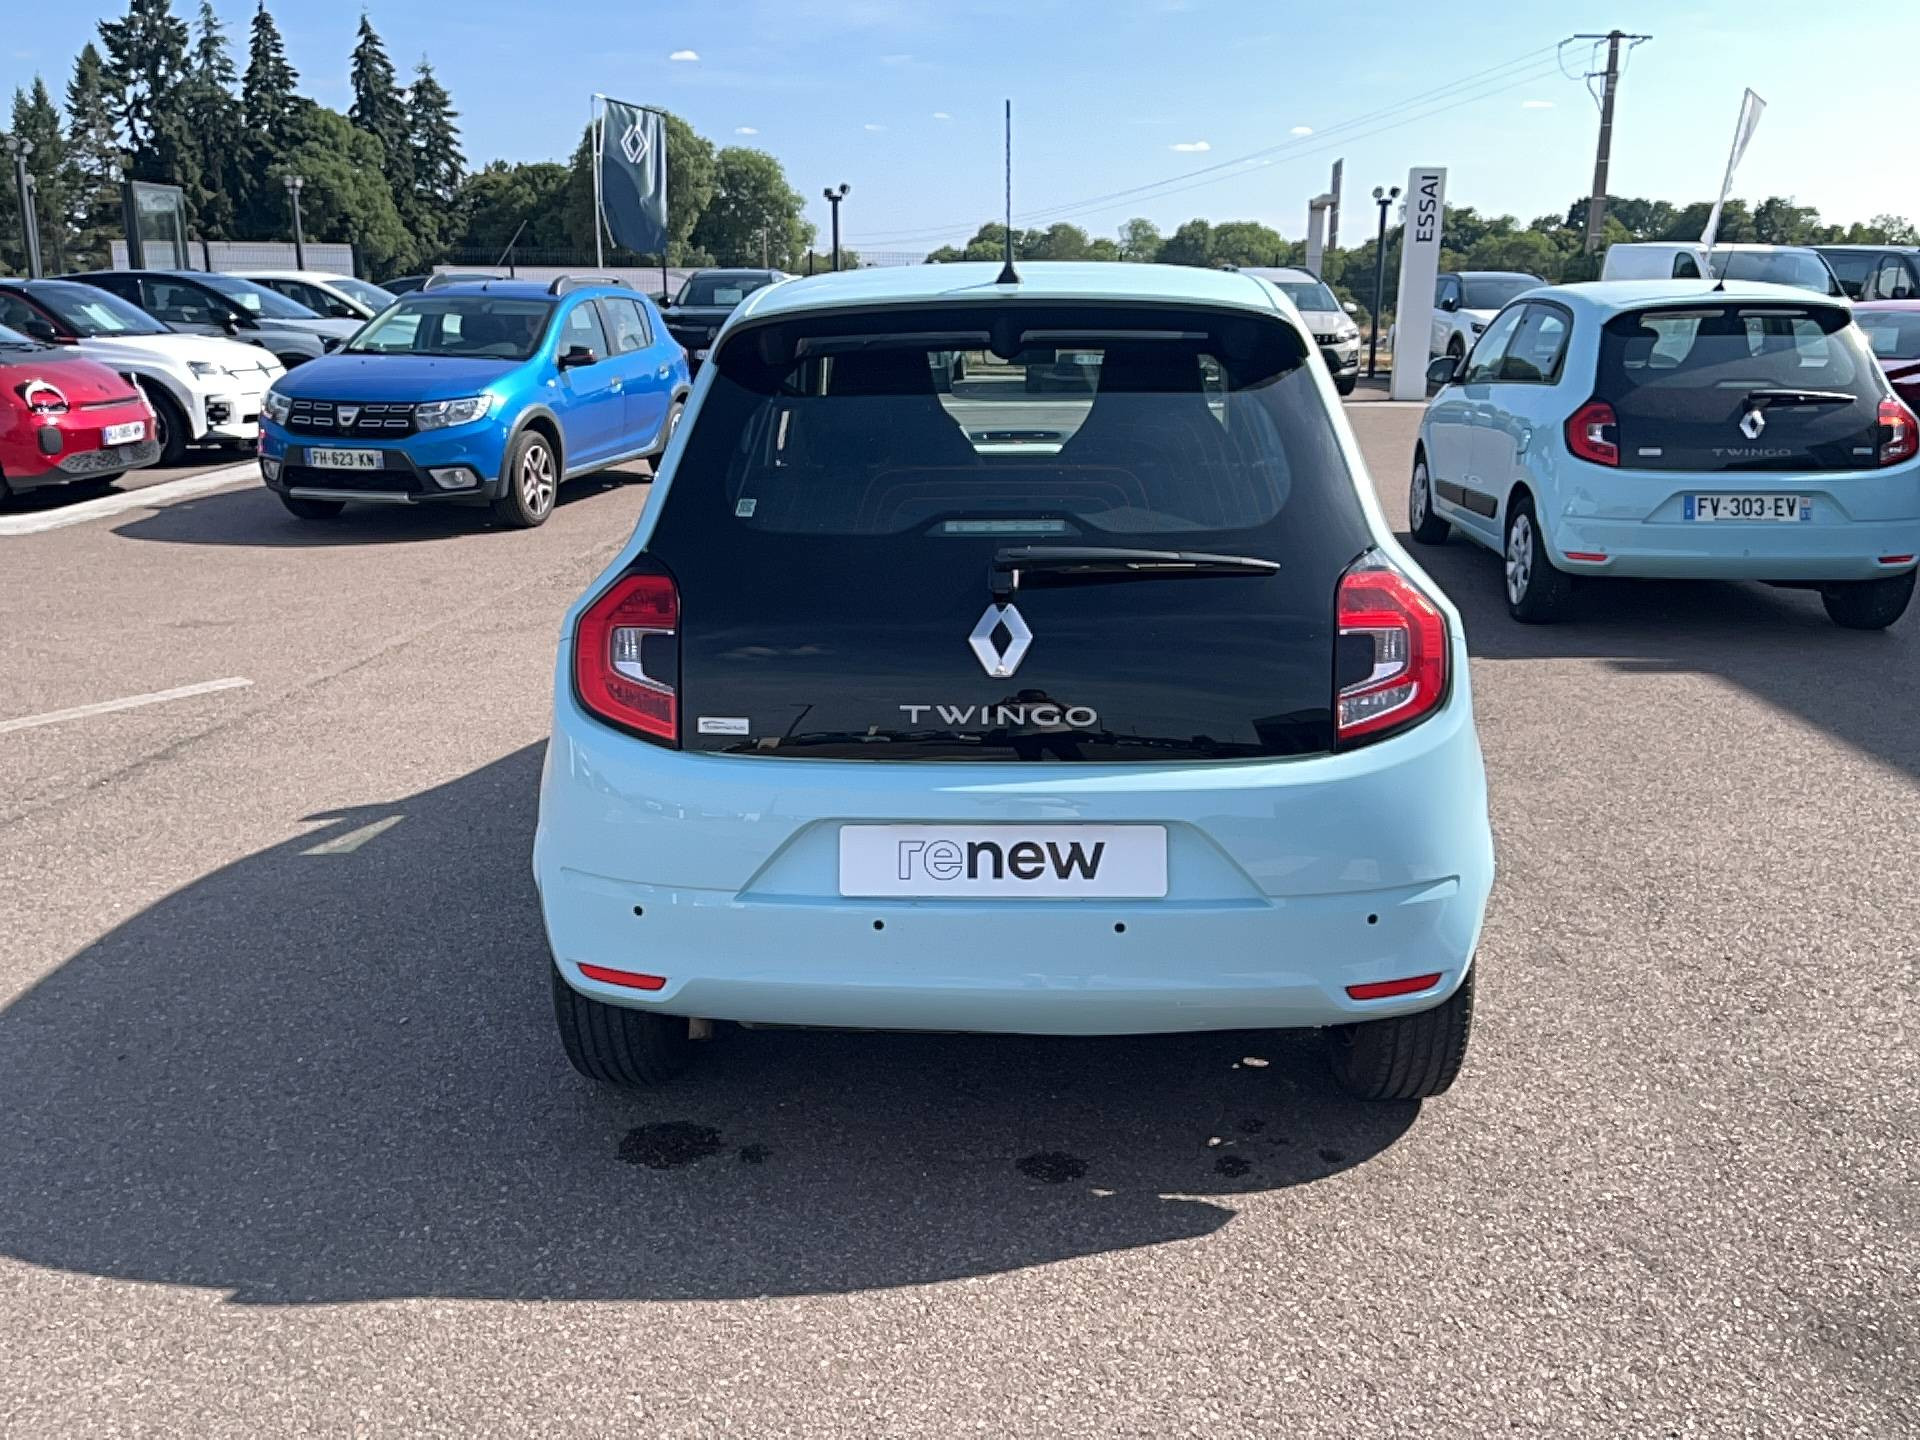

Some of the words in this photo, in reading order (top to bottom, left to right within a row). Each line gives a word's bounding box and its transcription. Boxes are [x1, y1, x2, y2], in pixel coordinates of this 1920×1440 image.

[1416, 175, 1438, 243] ESSAI
[1712, 448, 1792, 457] TWINGO
[1697, 497, 1796, 517] FV-303-EV
[899, 705, 1098, 726] TWINGO
[898, 840, 1105, 880] renew
